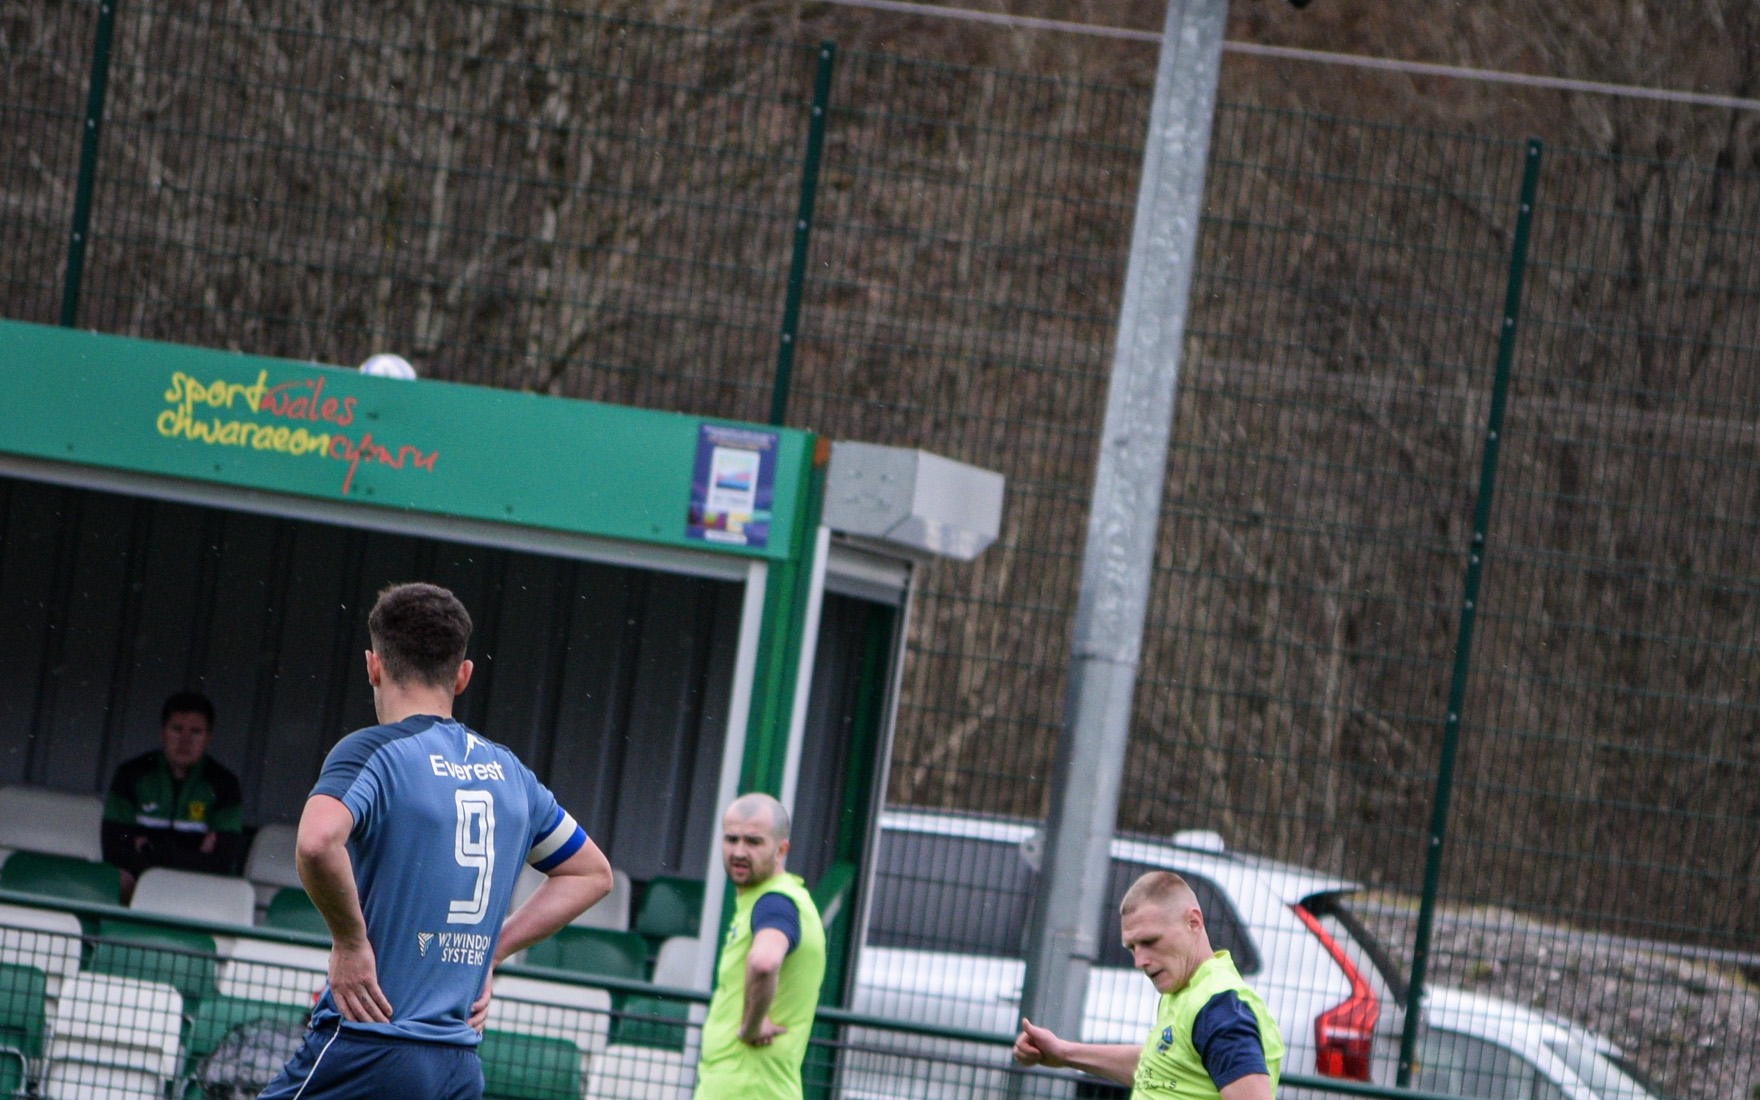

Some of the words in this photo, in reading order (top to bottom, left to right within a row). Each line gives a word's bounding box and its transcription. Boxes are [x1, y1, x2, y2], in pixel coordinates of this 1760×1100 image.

[429, 754, 505, 782] Everest
[446, 788, 495, 925] 9
[438, 932, 452, 948] W2
